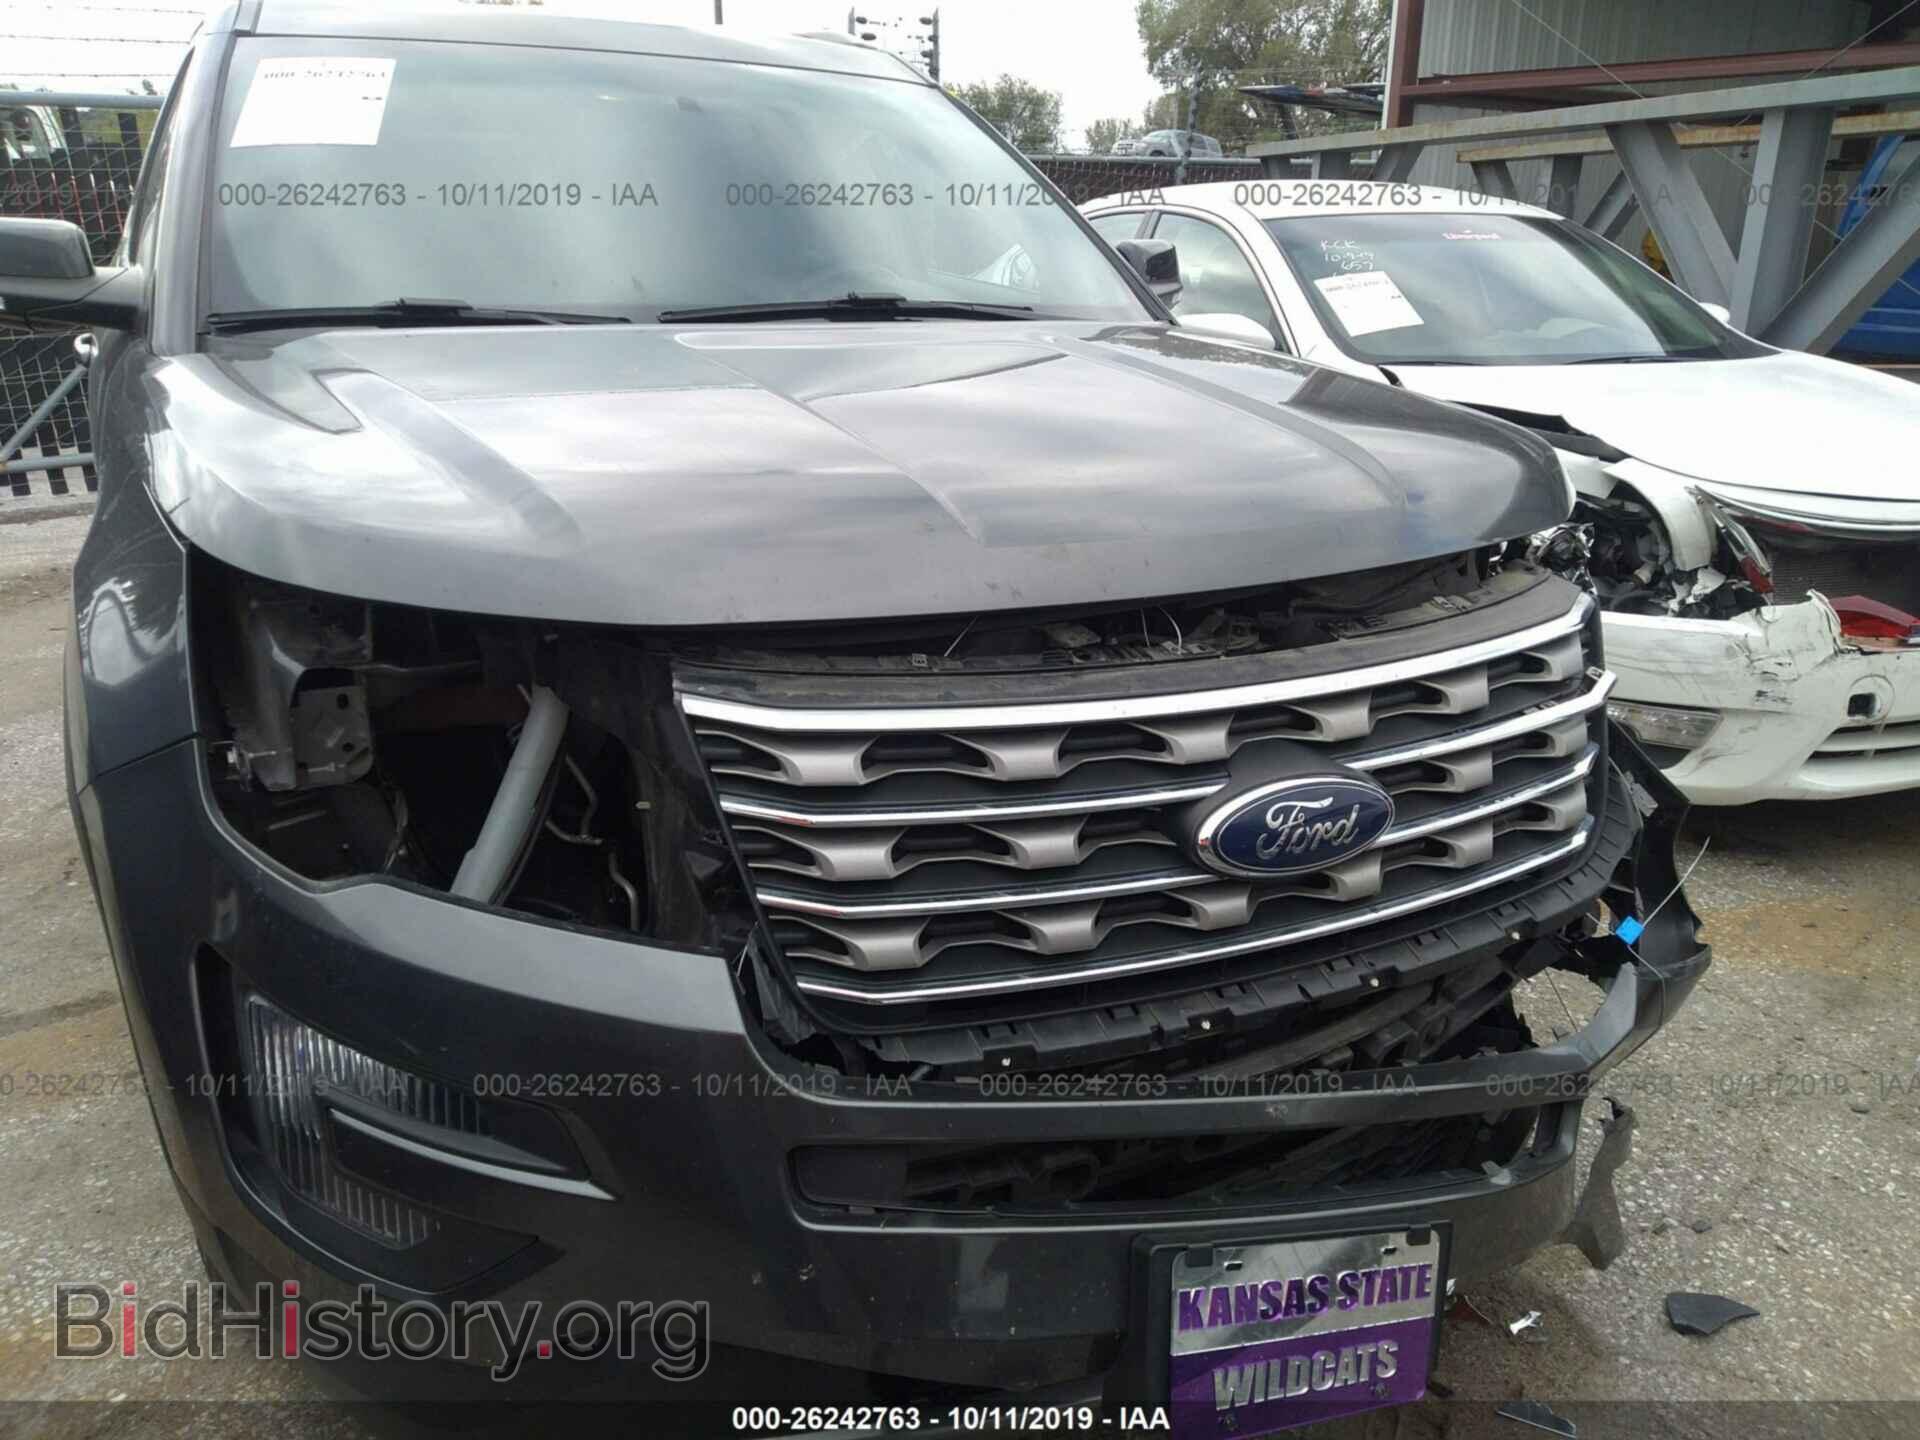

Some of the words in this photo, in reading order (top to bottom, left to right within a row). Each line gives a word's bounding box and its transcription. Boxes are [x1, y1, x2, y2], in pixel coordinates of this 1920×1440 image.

[1256, 797, 1361, 860] Ford
[1177, 1274, 1330, 1332] KANSAS
[1336, 1262, 1434, 1312] STATE
[1212, 1339, 1400, 1411] WILDCATS
